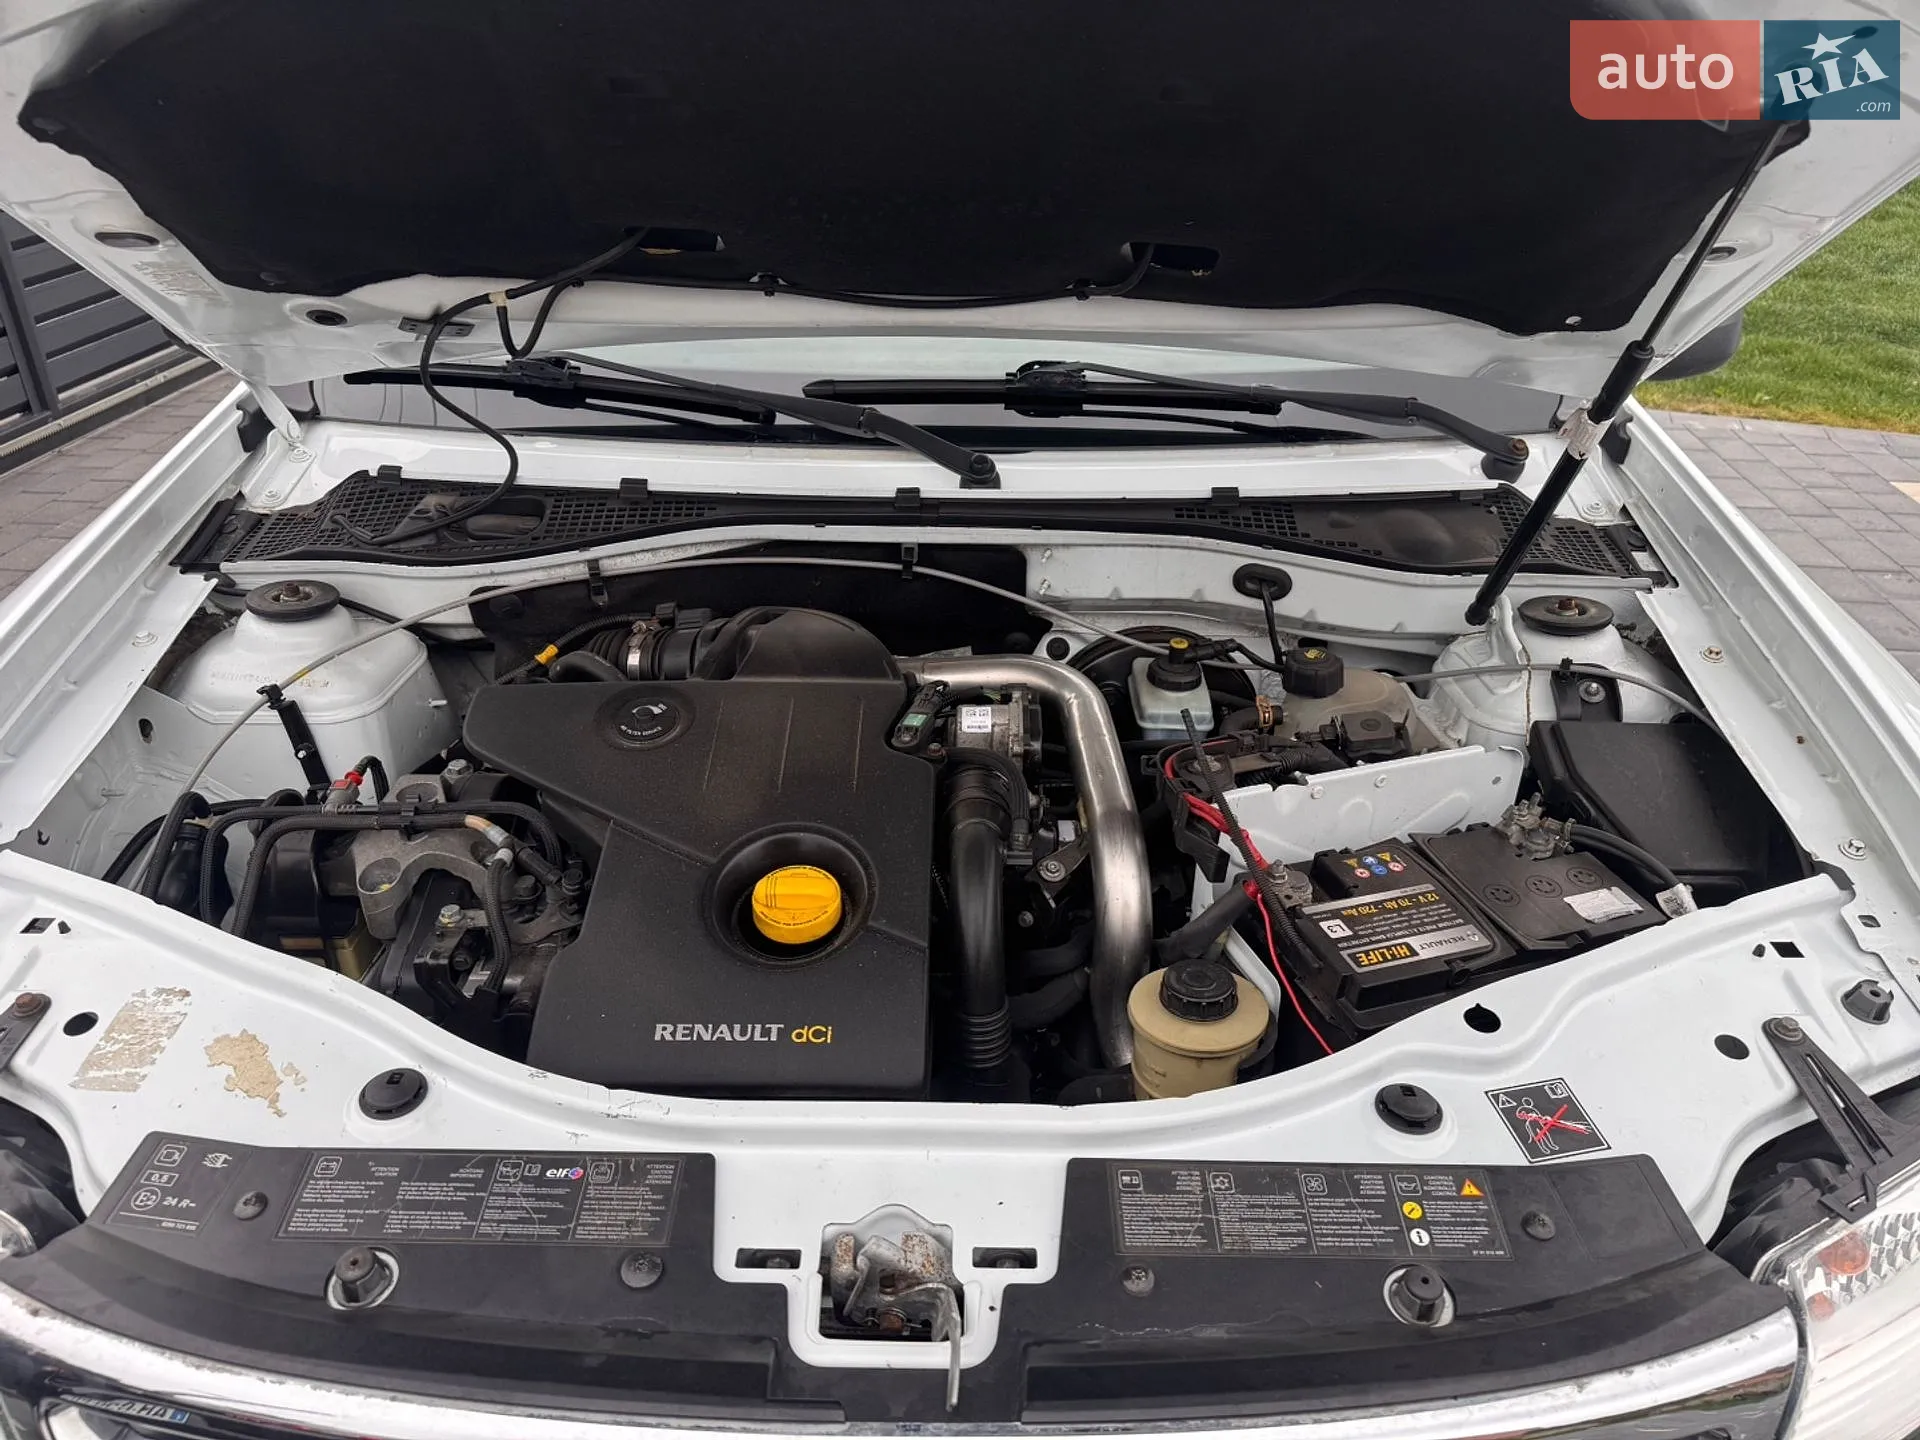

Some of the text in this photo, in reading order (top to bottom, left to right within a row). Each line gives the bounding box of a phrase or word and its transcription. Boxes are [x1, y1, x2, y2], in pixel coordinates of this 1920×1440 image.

[1418, 935, 1466, 951] RENAULT
[654, 1023, 833, 1044] RENAULT dCi
[545, 1166, 570, 1178] elf
[134, 1191, 157, 1206] E2
